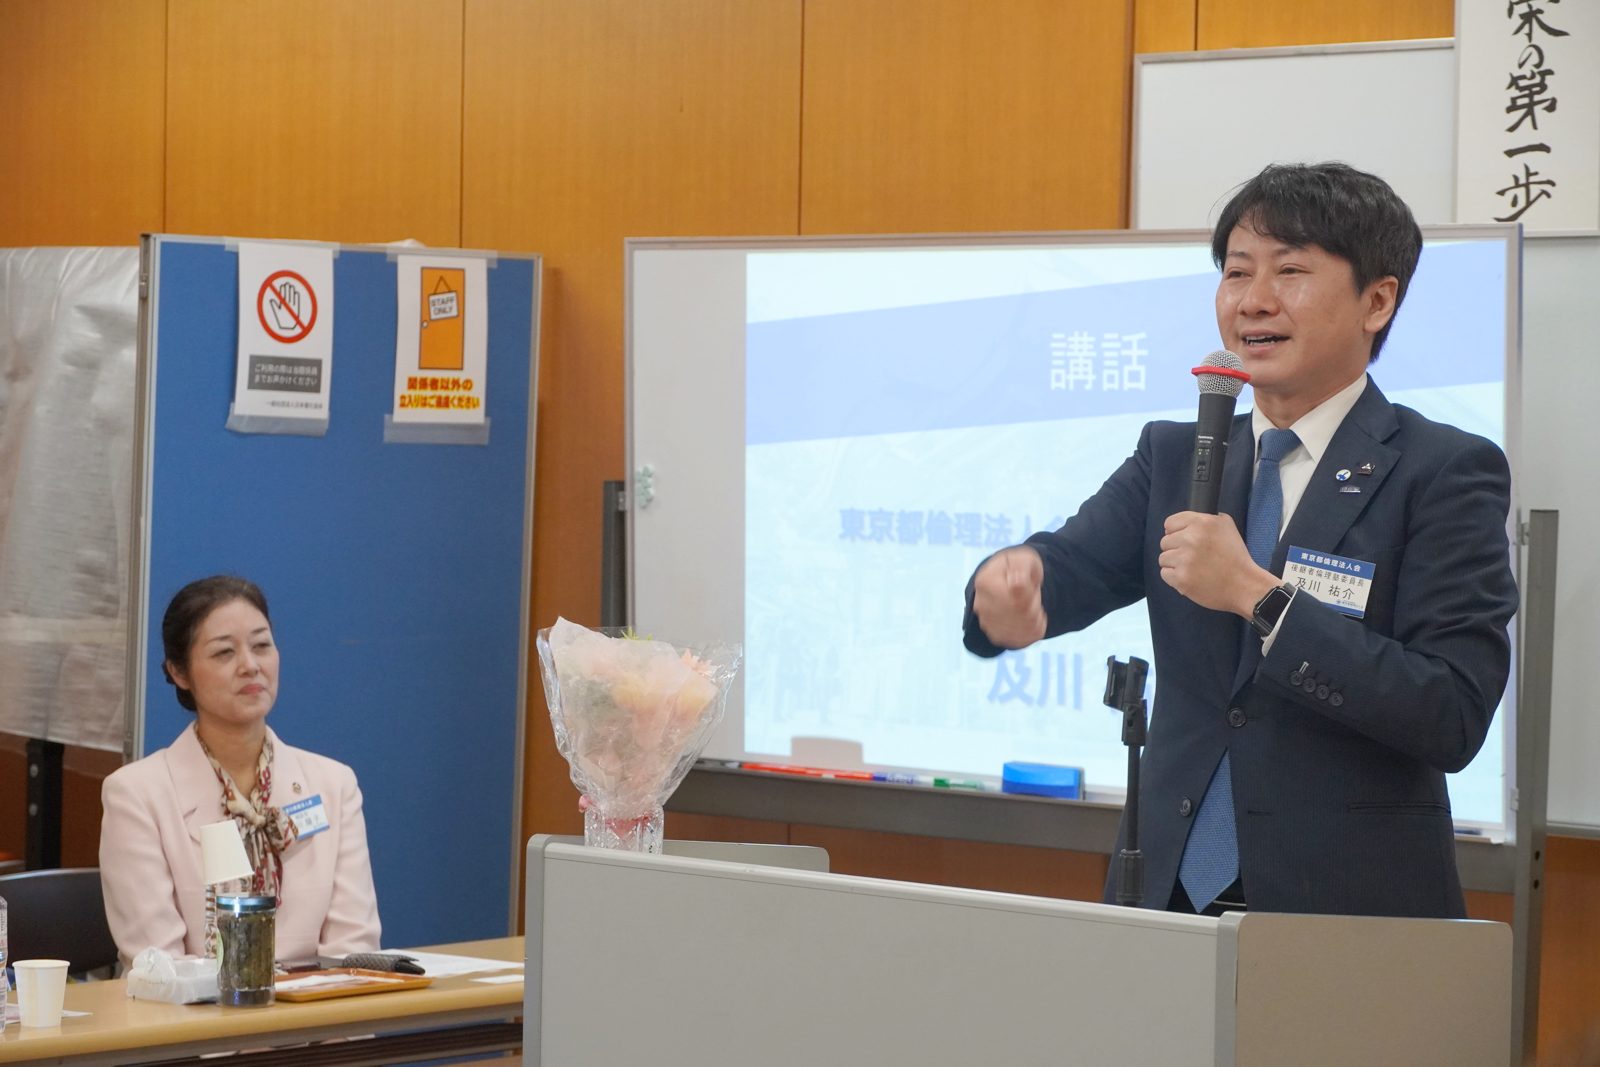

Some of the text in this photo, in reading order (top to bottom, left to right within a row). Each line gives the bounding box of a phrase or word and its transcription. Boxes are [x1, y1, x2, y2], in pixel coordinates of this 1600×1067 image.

[430, 296, 455, 307] STAFF
[432, 305, 454, 316] ONLY
[1050, 331, 1149, 391] 講話
[407, 376, 474, 391] 関係者以外の
[839, 507, 1064, 548] 東京都倫理法人
[1300, 552, 1362, 572] 東京都倫理法人会
[1295, 576, 1355, 600] 及川 祐介
[986, 651, 1083, 712] 及川
